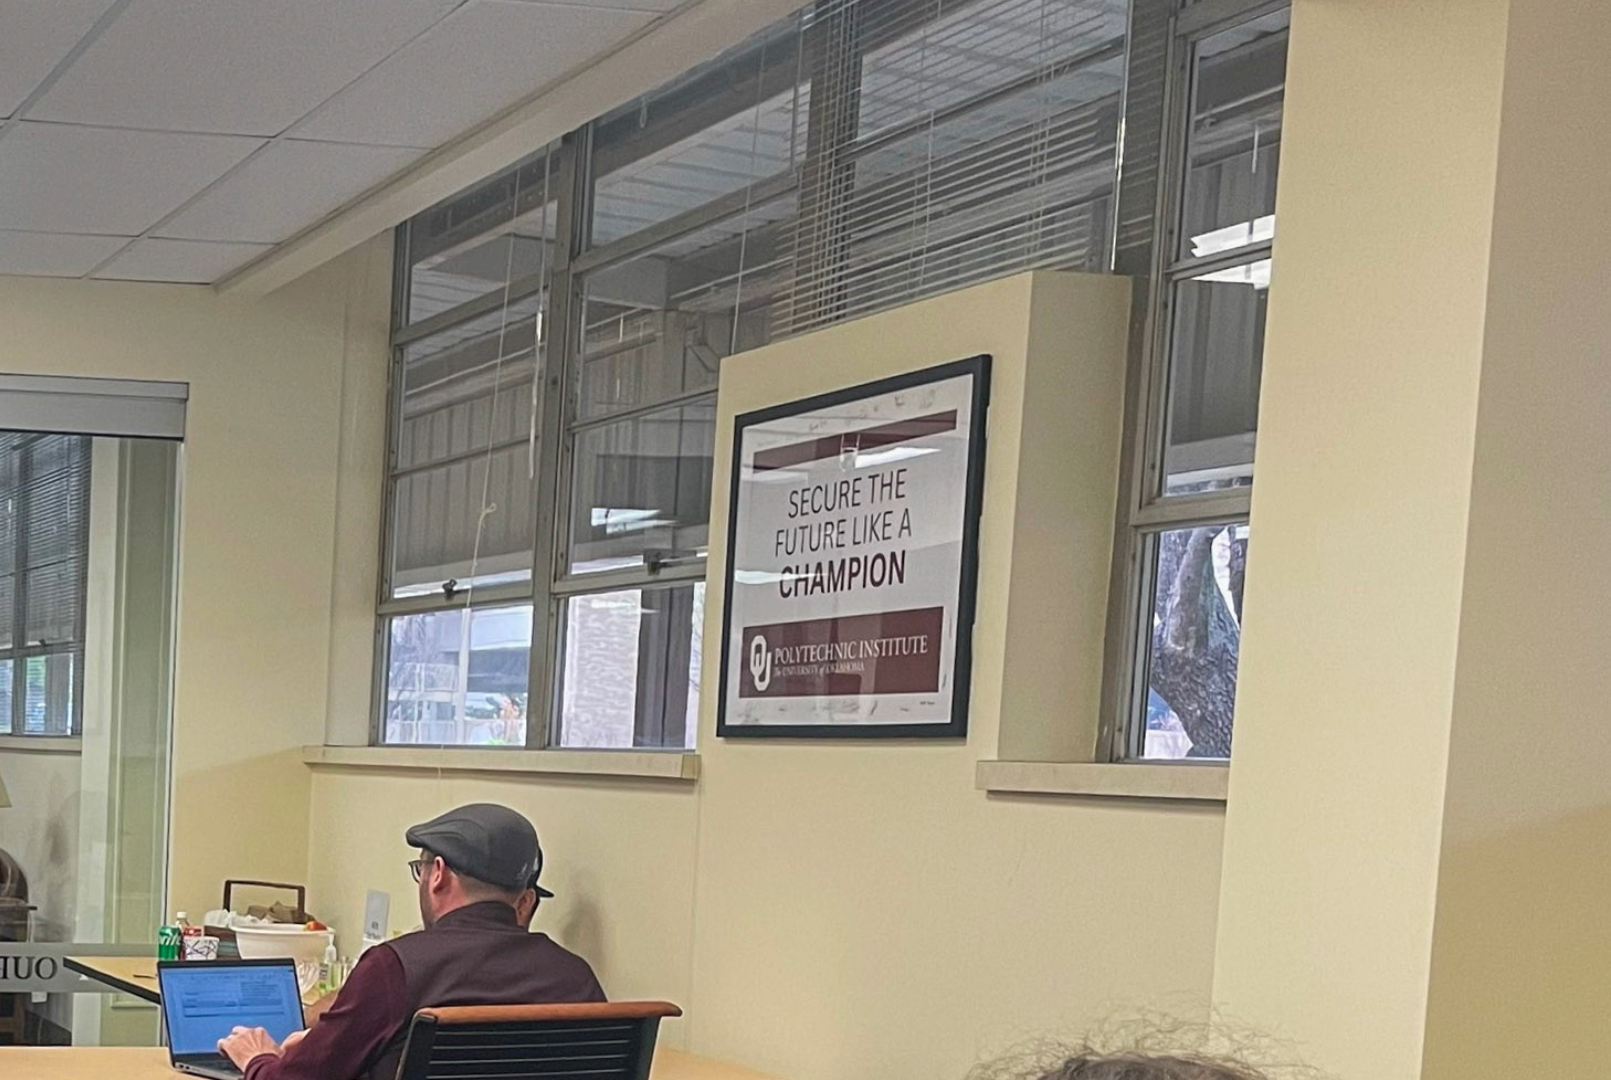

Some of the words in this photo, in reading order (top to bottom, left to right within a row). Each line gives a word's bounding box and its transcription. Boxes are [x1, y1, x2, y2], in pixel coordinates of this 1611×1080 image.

[788, 476, 863, 519] SECURE
[867, 468, 908, 505] THE
[775, 518, 848, 558] FUTURE
[852, 510, 894, 546] LIKE
[897, 507, 912, 539] A
[779, 549, 907, 599] CHAMPION
[774, 640, 858, 665] POLYTECHNIC
[859, 635, 928, 658] INSTITUTE
